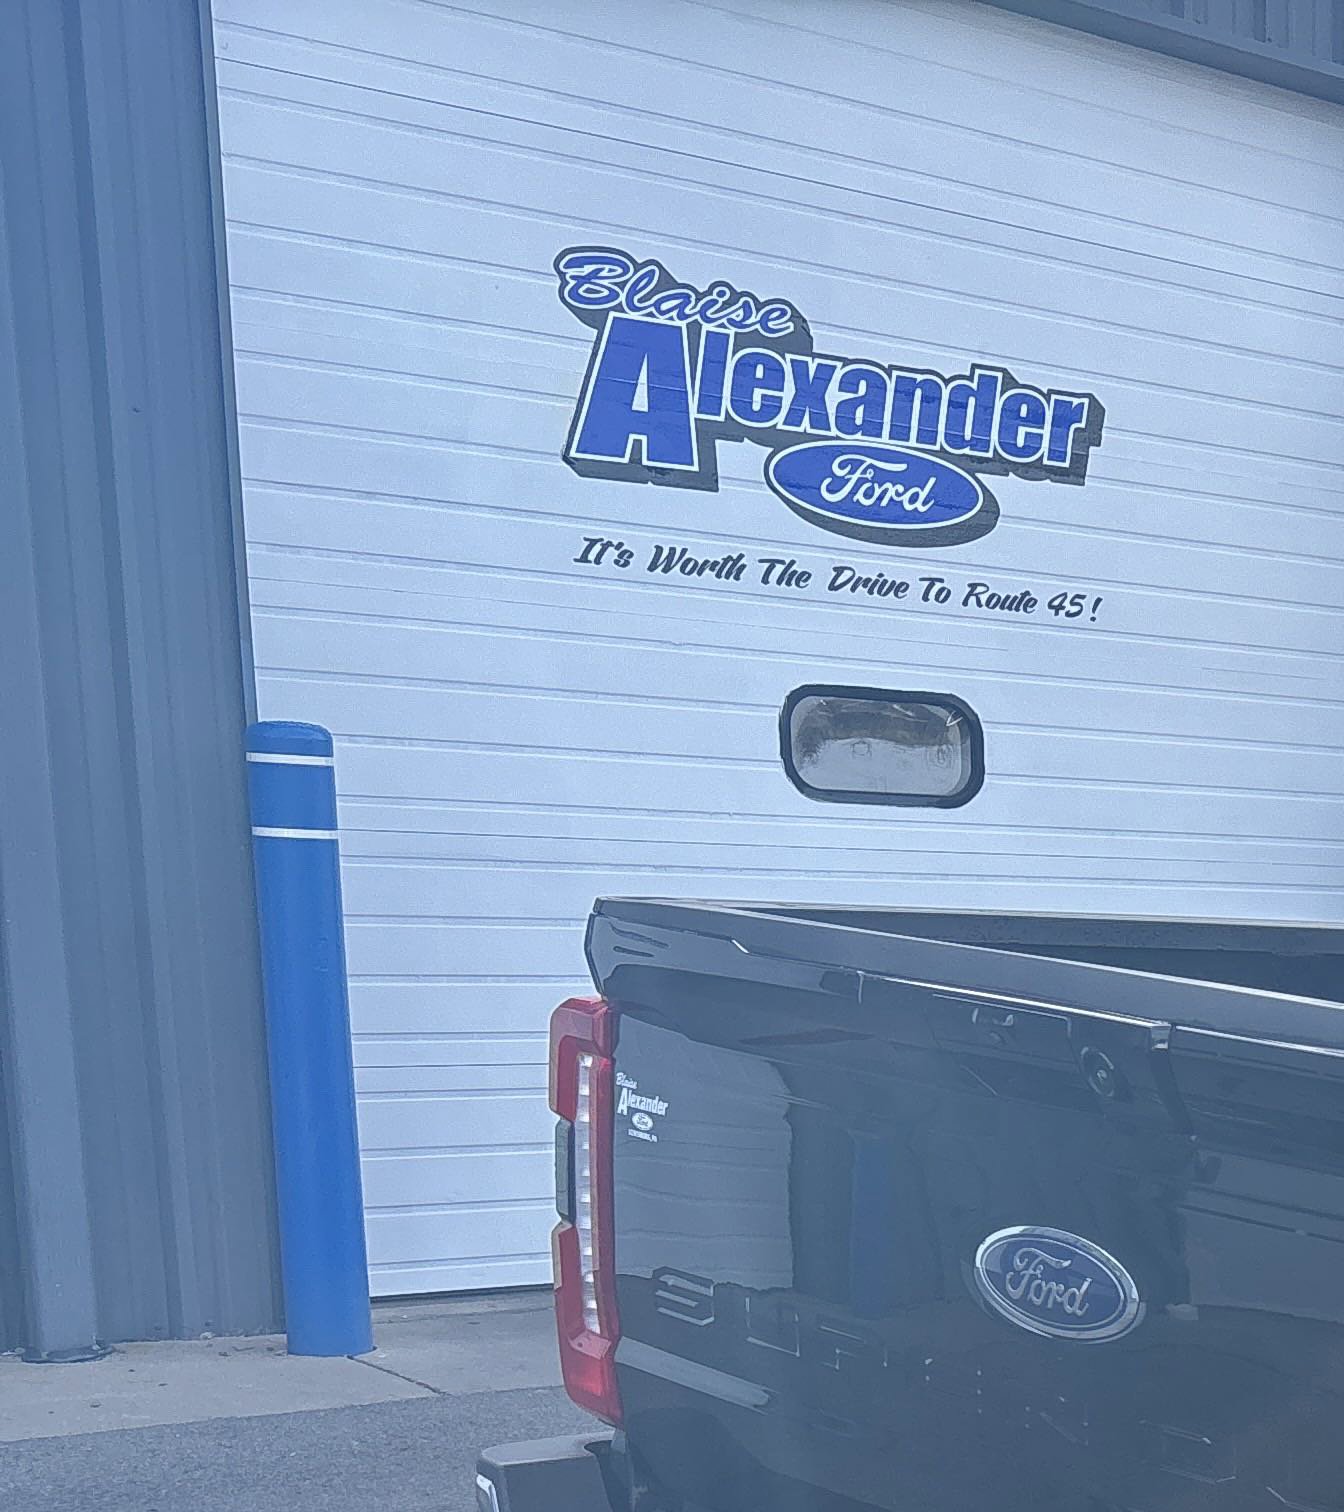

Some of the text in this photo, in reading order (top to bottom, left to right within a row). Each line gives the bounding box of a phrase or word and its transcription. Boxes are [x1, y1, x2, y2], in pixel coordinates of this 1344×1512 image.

[556, 248, 798, 338] Blaise
[567, 310, 1096, 474] Alexander
[819, 453, 936, 514] Ford
[573, 536, 1104, 623] It's Worth The Drive To Route 45!
[616, 1087, 669, 1117] Alexander
[1005, 1246, 1092, 1317] Ford
